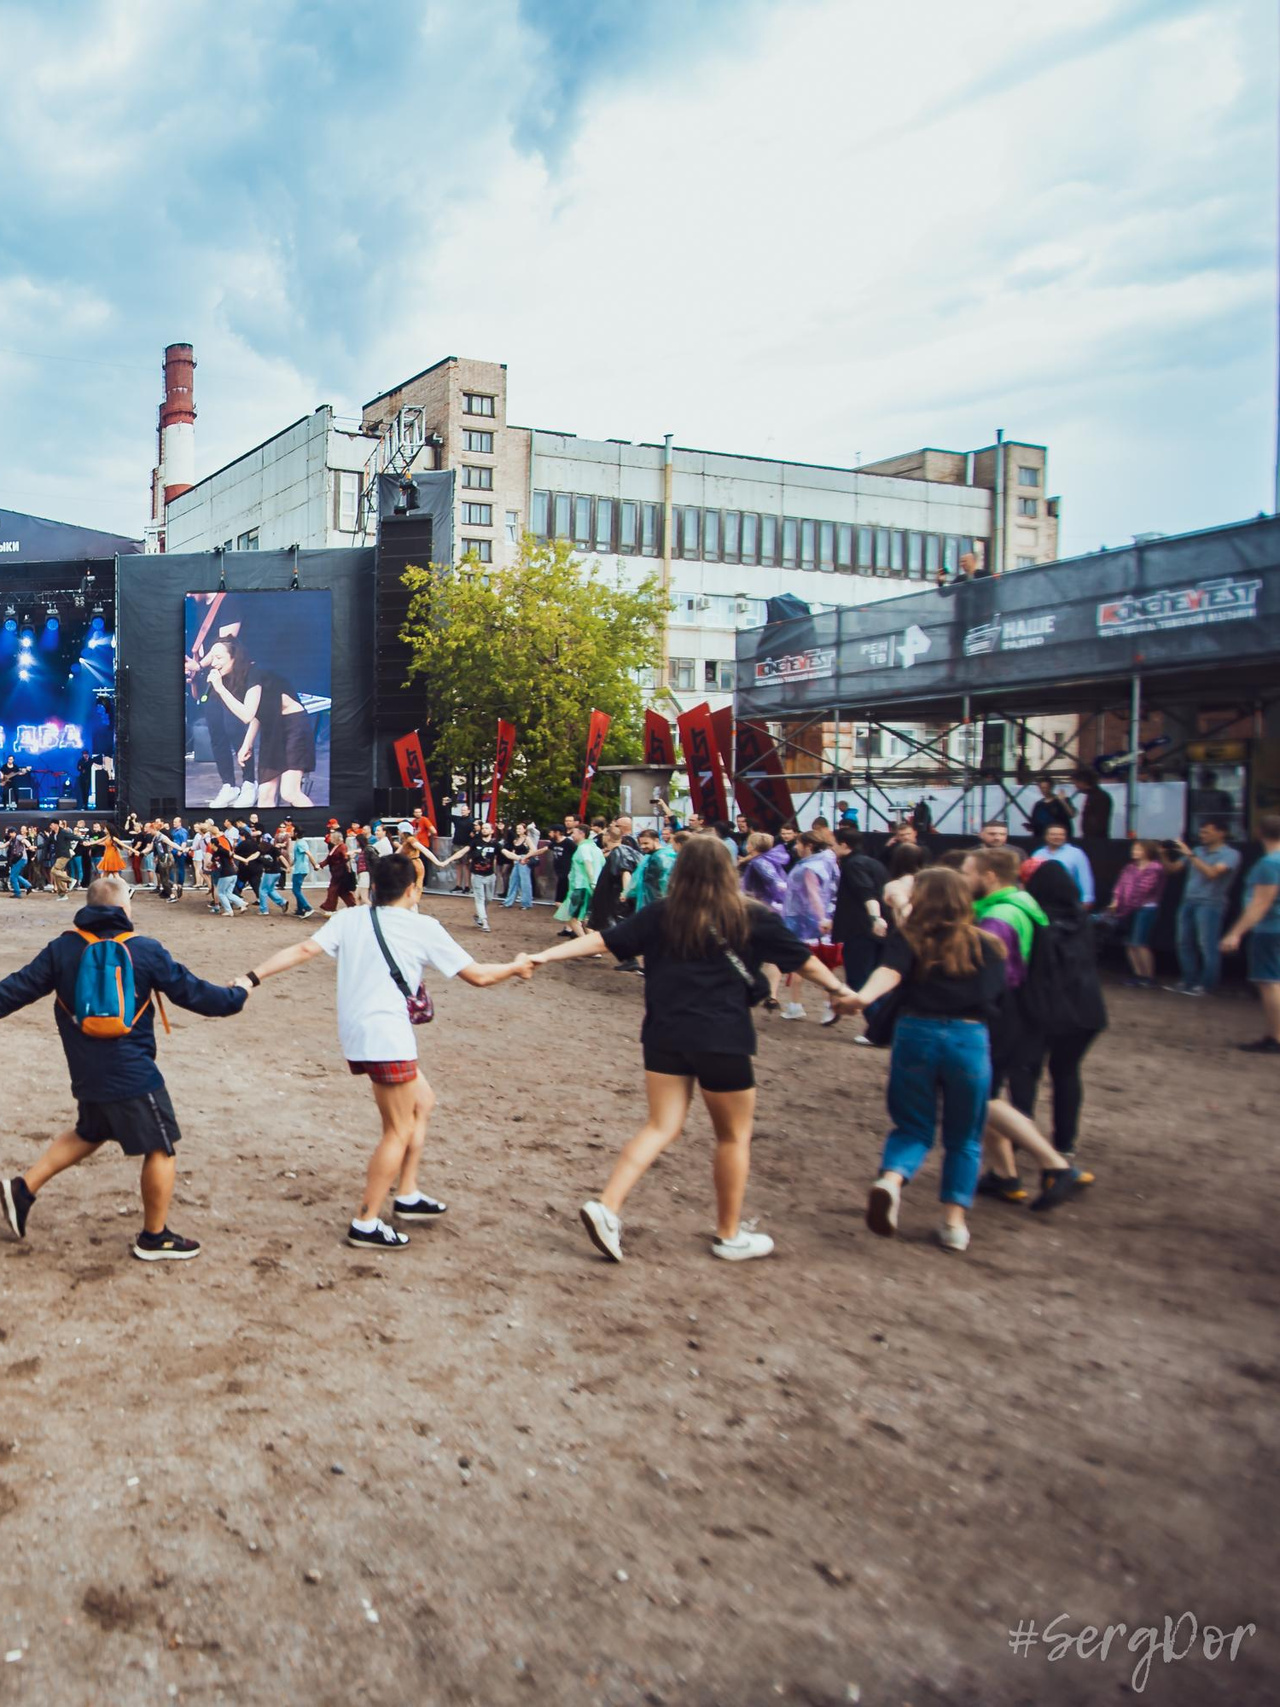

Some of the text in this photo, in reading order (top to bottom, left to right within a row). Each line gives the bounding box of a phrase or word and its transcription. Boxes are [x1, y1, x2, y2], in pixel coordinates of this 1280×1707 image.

[1002, 615, 1056, 639] НАШЕ
[861, 641, 889, 655] РЕН
[869, 654, 887, 664] ТВ
[14, 722, 83, 754] ДВА
